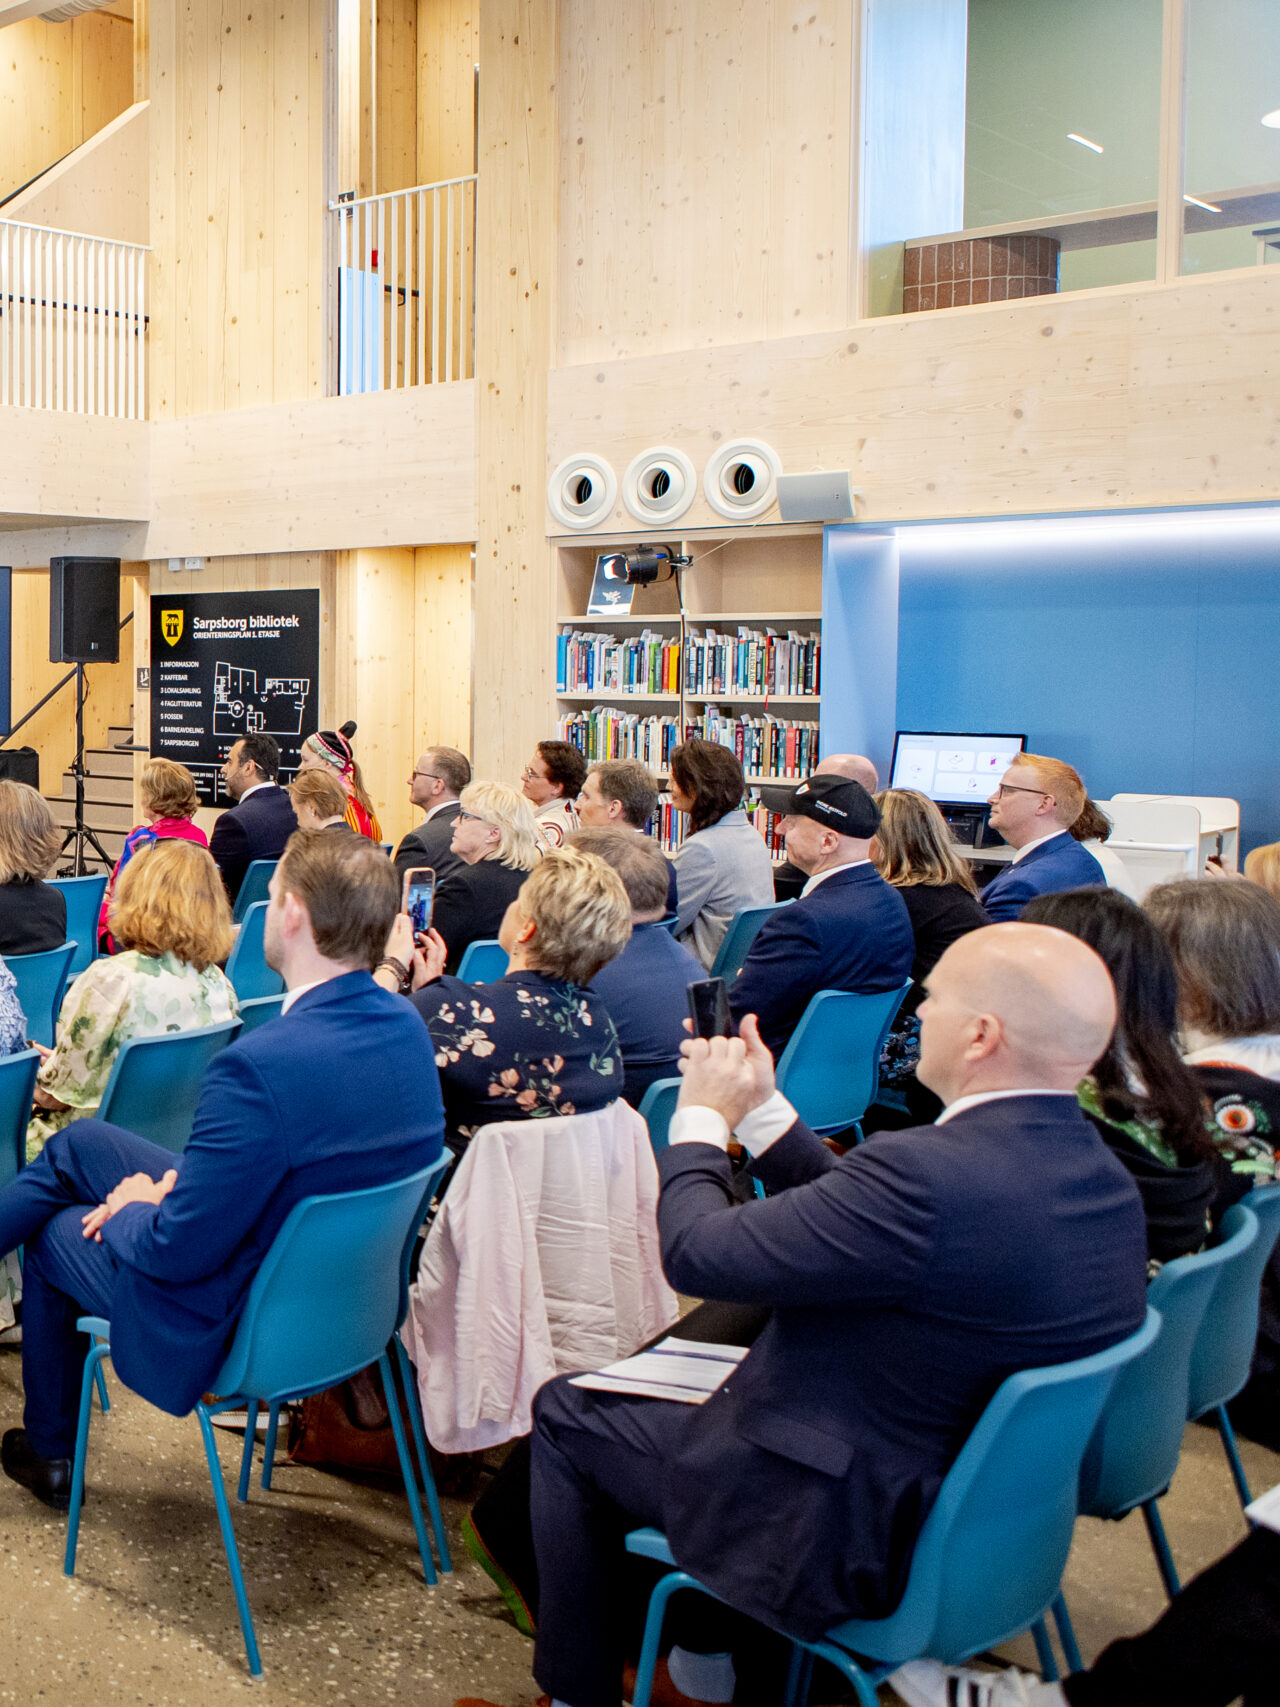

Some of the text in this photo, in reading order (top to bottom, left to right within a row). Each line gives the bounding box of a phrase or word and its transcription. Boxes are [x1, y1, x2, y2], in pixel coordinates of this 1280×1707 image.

[193, 614, 300, 631] Sarpsborg bibliotek
[193, 631, 251, 639] ORIENTERINGSPLAN
[258, 630, 281, 638] ETASJE
[164, 739, 199, 747] SARPSBORGEN
